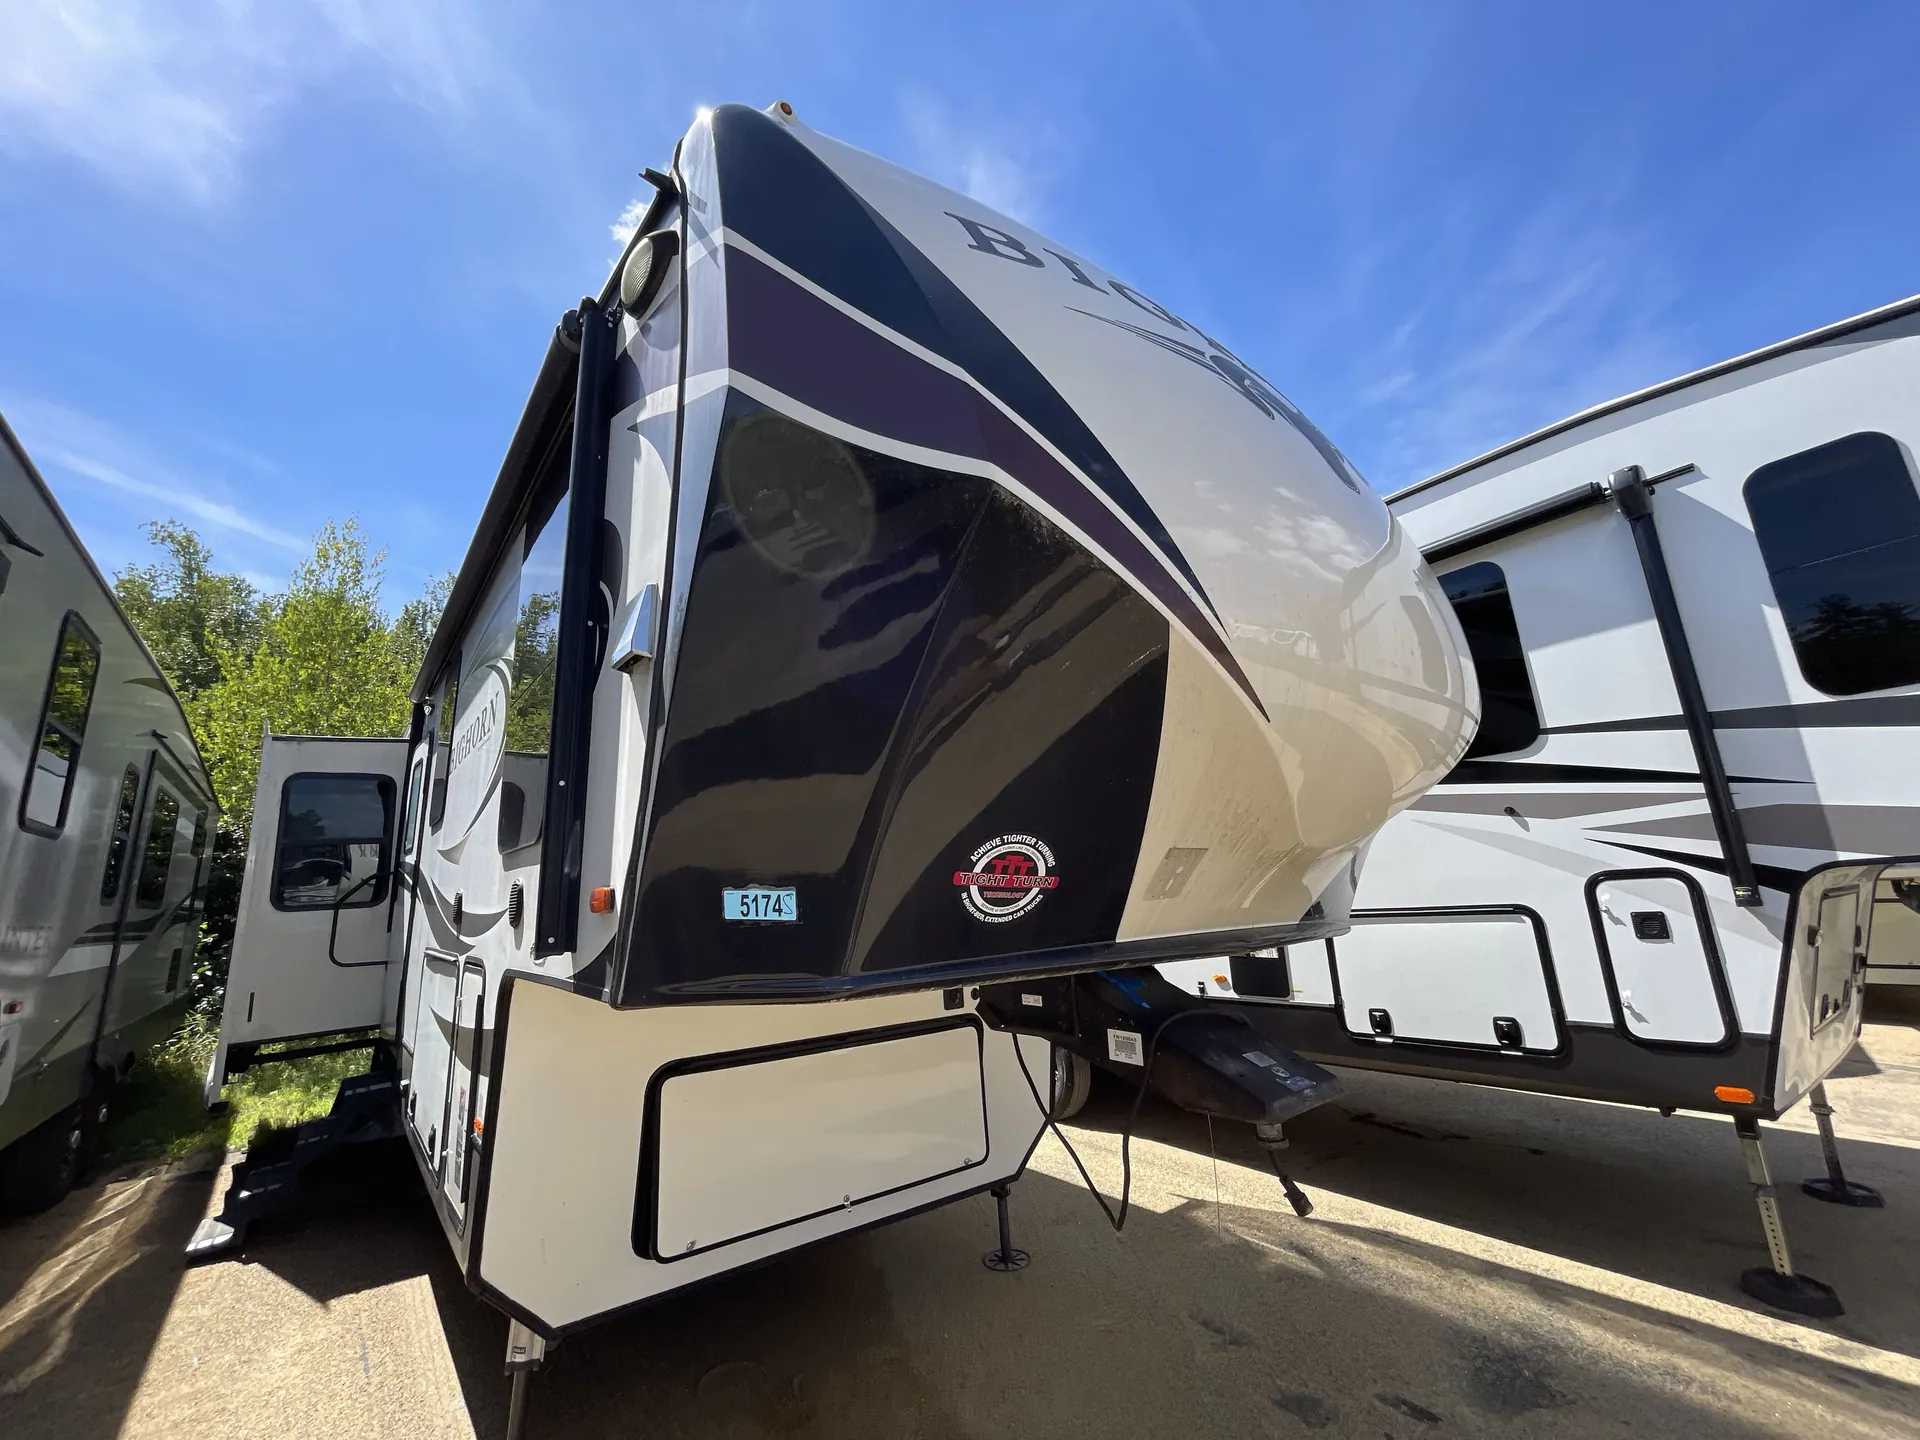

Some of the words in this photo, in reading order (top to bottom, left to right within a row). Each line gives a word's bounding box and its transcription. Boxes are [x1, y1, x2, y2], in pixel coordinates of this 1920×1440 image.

[970, 837, 1002, 863] ACHIEVE
[1002, 834, 1037, 846] TIGHTER
[1035, 840, 1056, 868] TURNING
[991, 854, 1035, 876] TTT
[959, 872, 1009, 886] TIGHT
[1012, 875, 1055, 888] TURN
[983, 890, 1026, 899] TECHNOLOGY
[984, 914, 1013, 923] EXTENDED
[1012, 909, 1025, 919] CAB
[1024, 894, 1044, 913] TRUCKS
